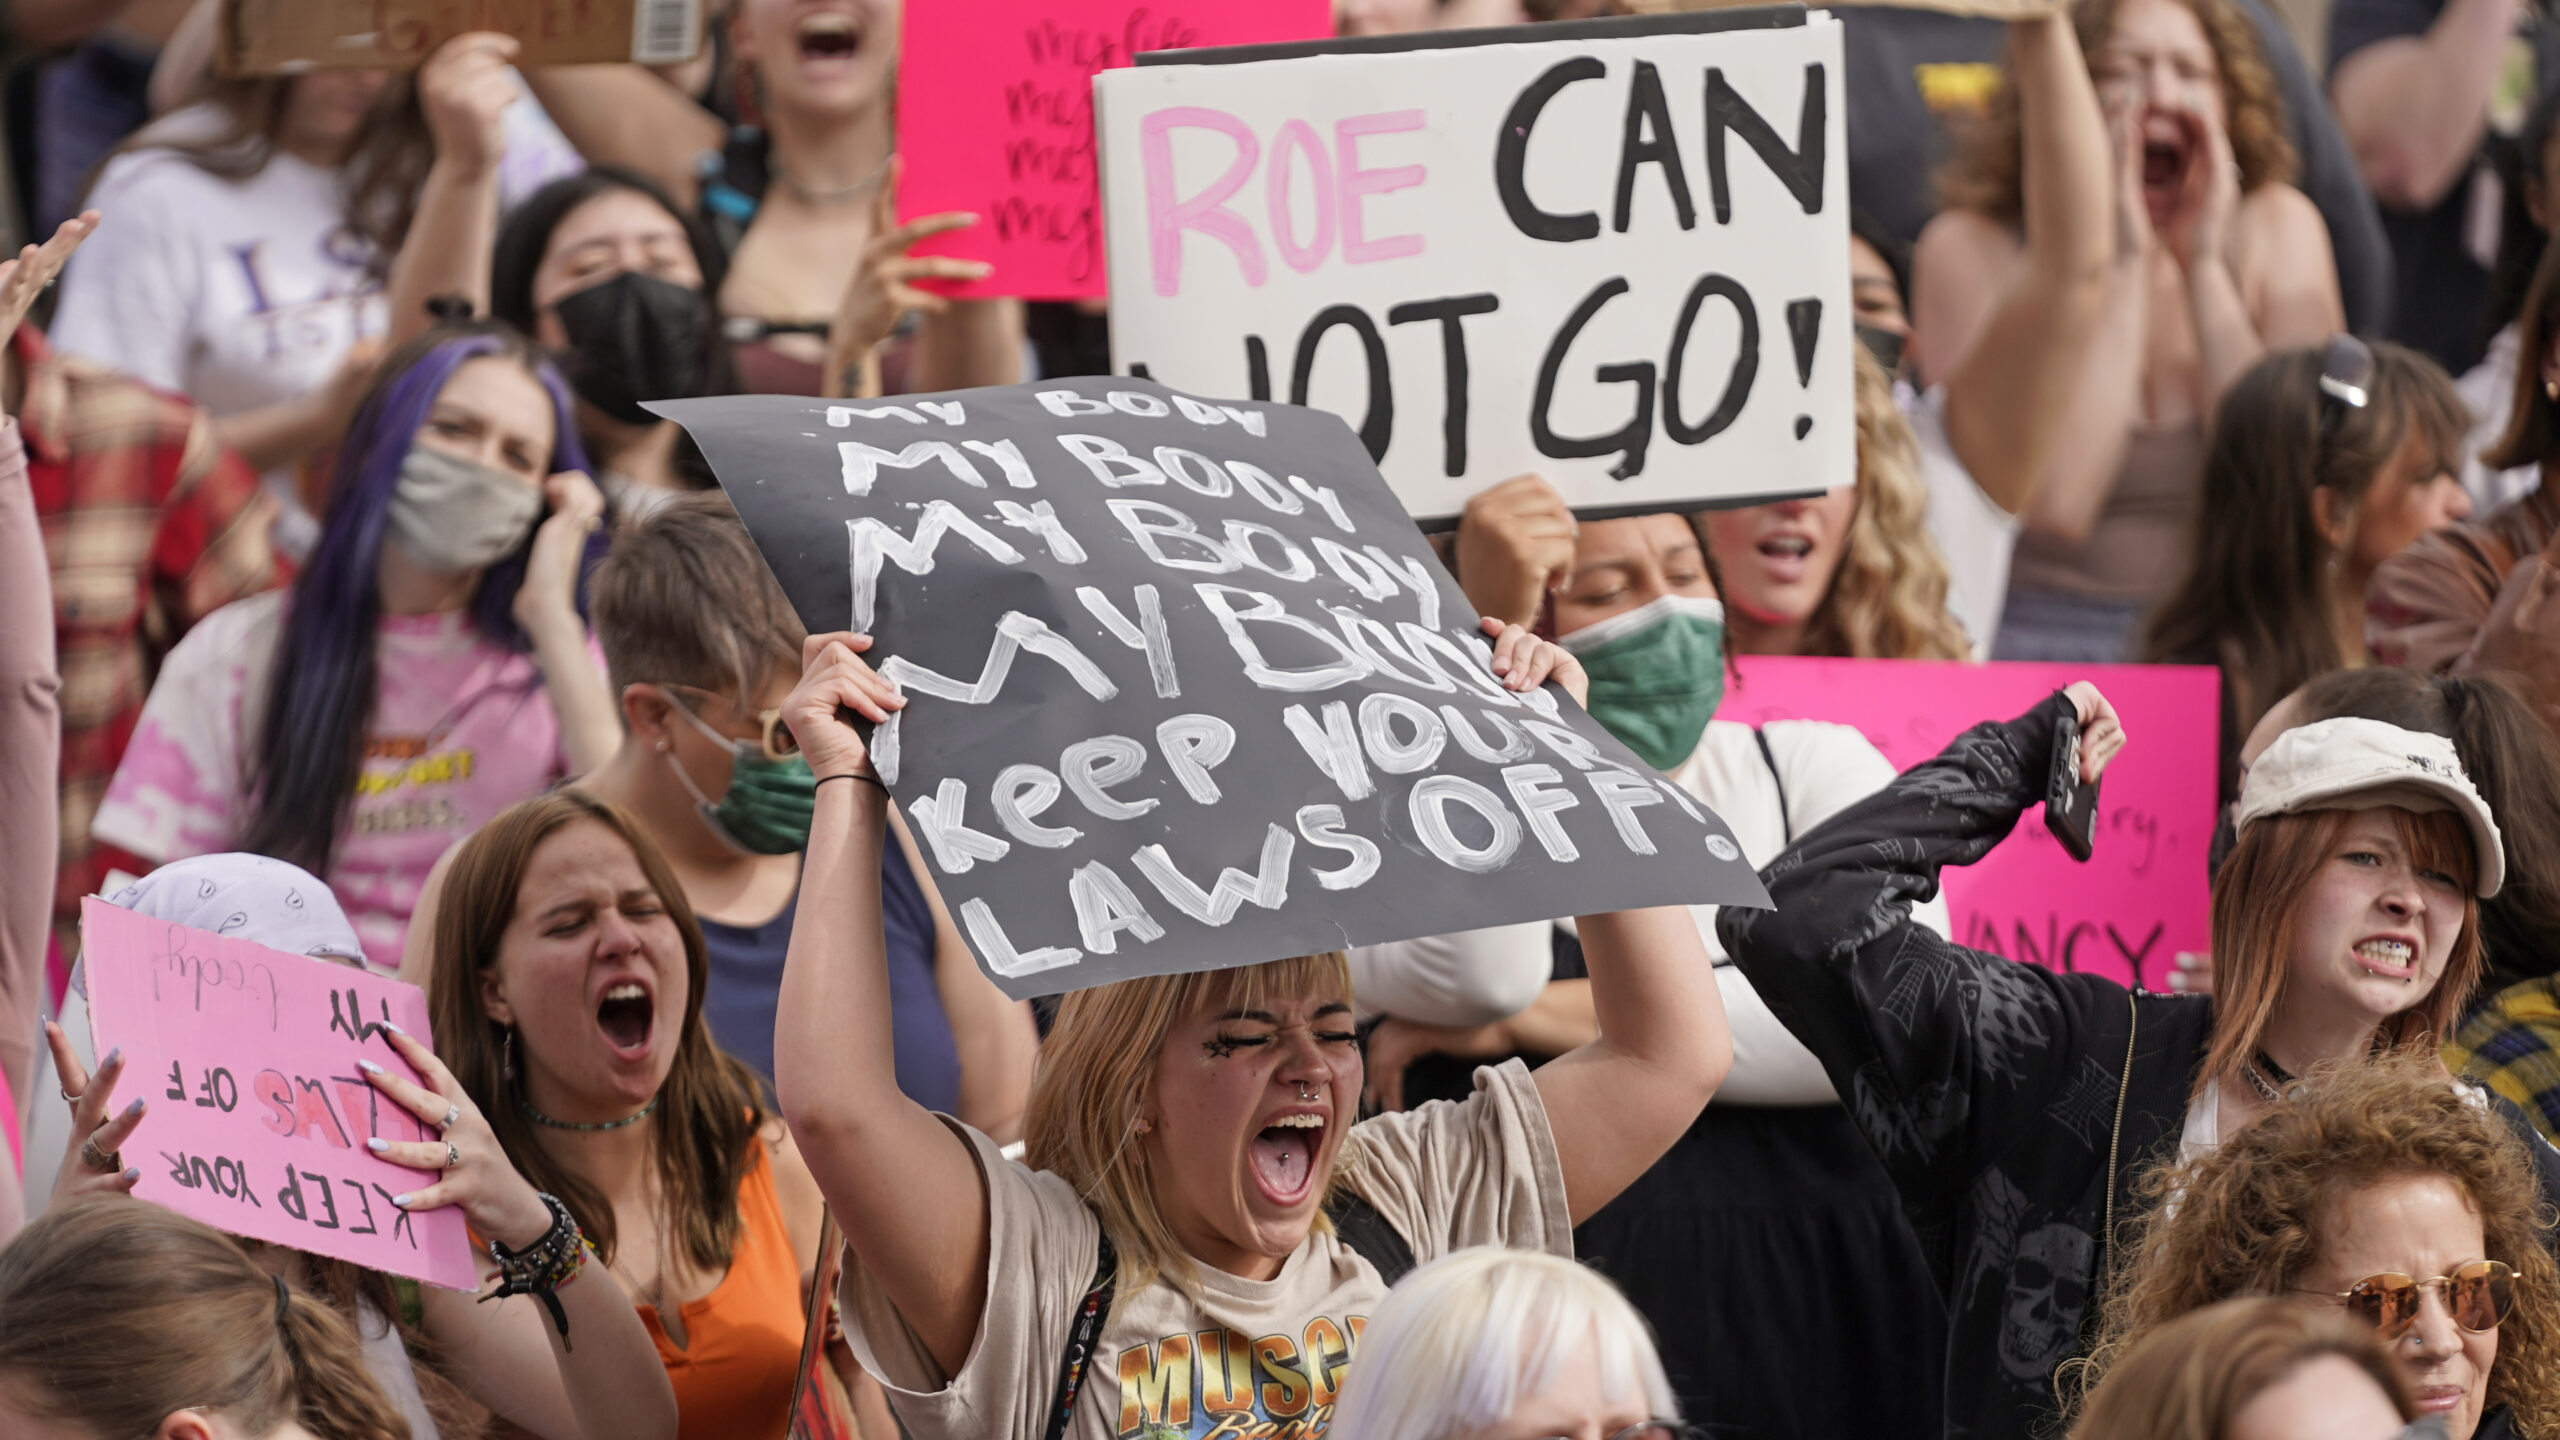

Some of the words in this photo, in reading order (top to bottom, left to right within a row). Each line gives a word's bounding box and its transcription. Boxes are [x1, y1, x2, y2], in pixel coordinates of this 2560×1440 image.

[1141, 106, 1426, 297] ROE
[1495, 56, 1826, 243] CAN
[826, 400, 966, 428] MY
[1035, 389, 1267, 438] BODY
[1530, 272, 1823, 481] GO!
[837, 438, 1037, 496] MY
[1057, 434, 1355, 533] BODY
[846, 499, 1088, 634] MY
[1107, 499, 1441, 632] BODY
[871, 583, 1181, 786] MY
[1283, 693, 1642, 801] YOUR
[960, 804, 1382, 979] LAWS
[1408, 762, 1740, 875] OFF!
[330, 988, 398, 1052] MY
[166, 1060, 238, 1113] OFF
[160, 1151, 262, 1208] YOUR
[277, 1163, 417, 1250] KEEP
